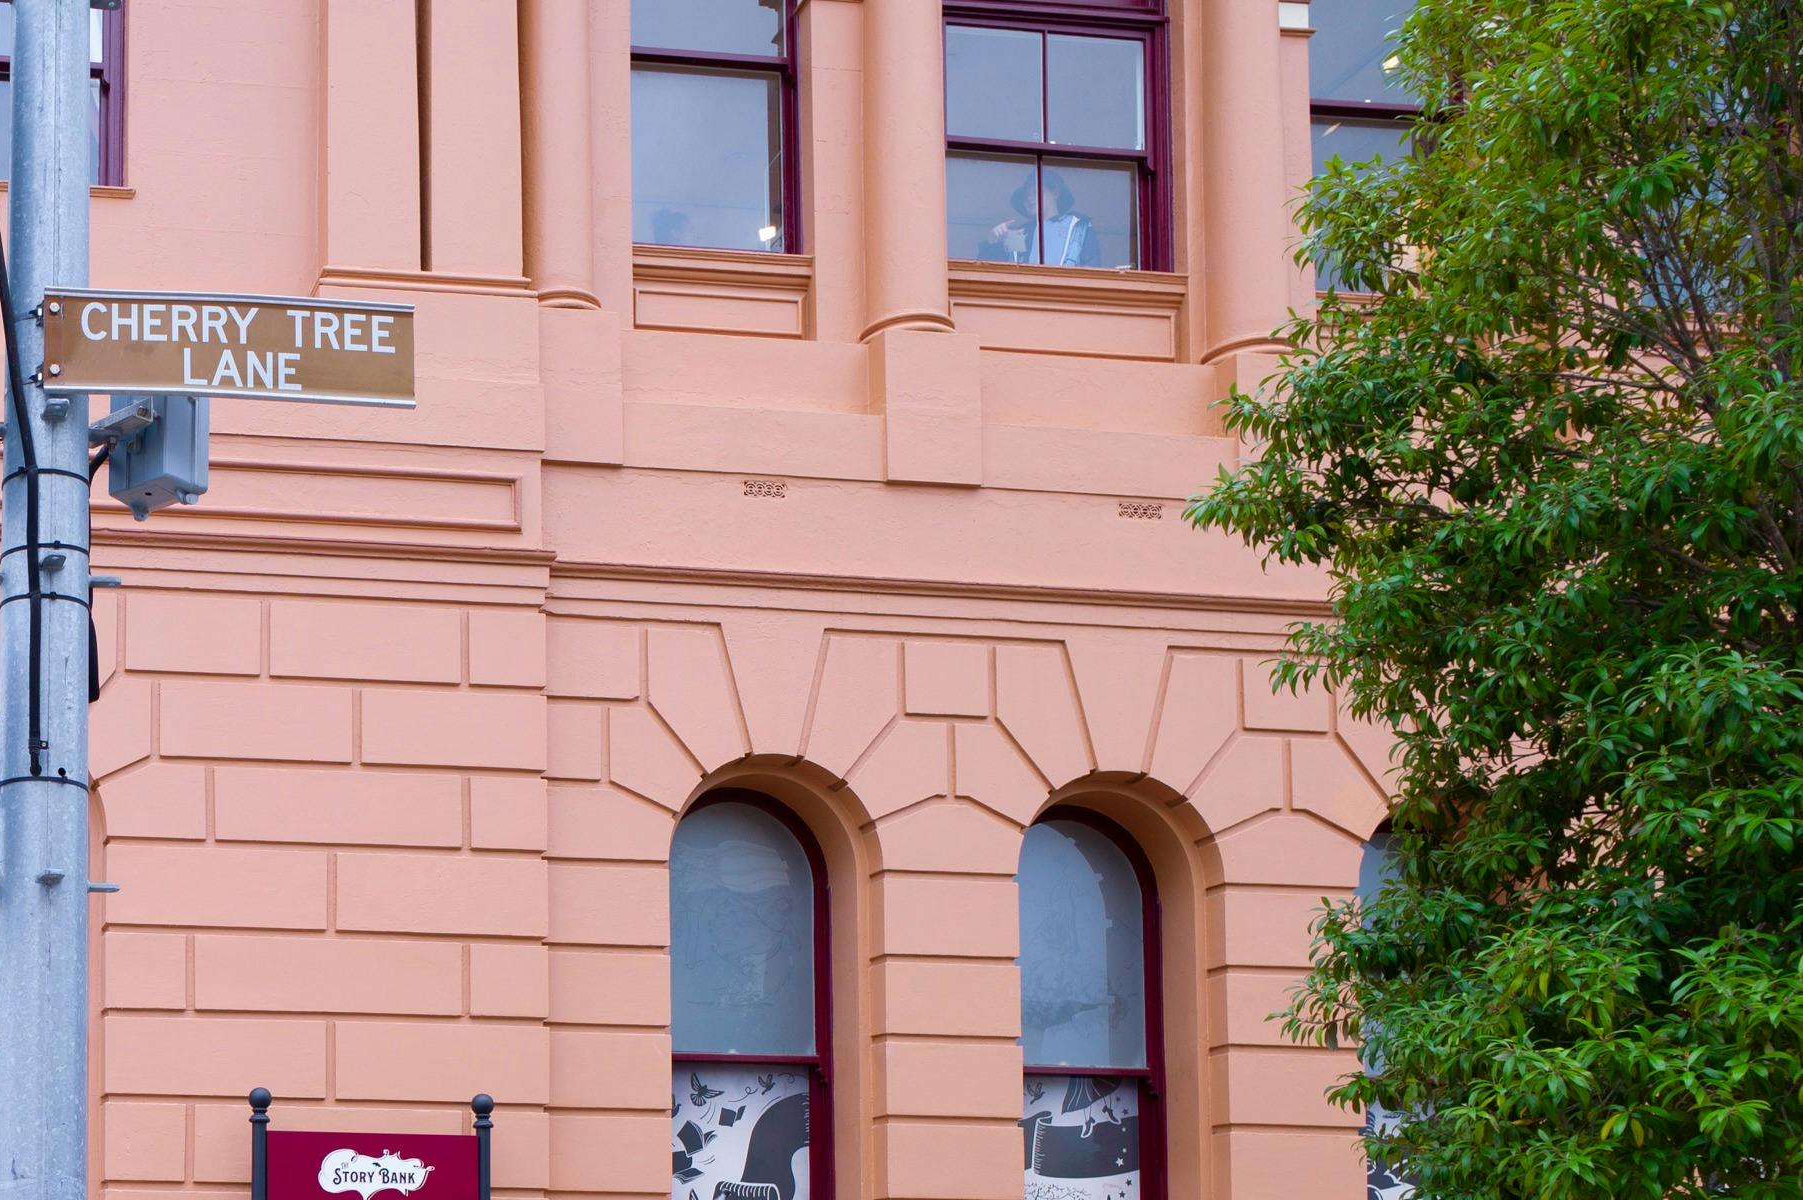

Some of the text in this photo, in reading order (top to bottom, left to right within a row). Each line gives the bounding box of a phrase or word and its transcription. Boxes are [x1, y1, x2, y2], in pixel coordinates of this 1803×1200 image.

[80, 301, 396, 353] CHERRY TREE
[182, 347, 302, 391] LANE
[332, 1167, 416, 1185] STORY BANK
